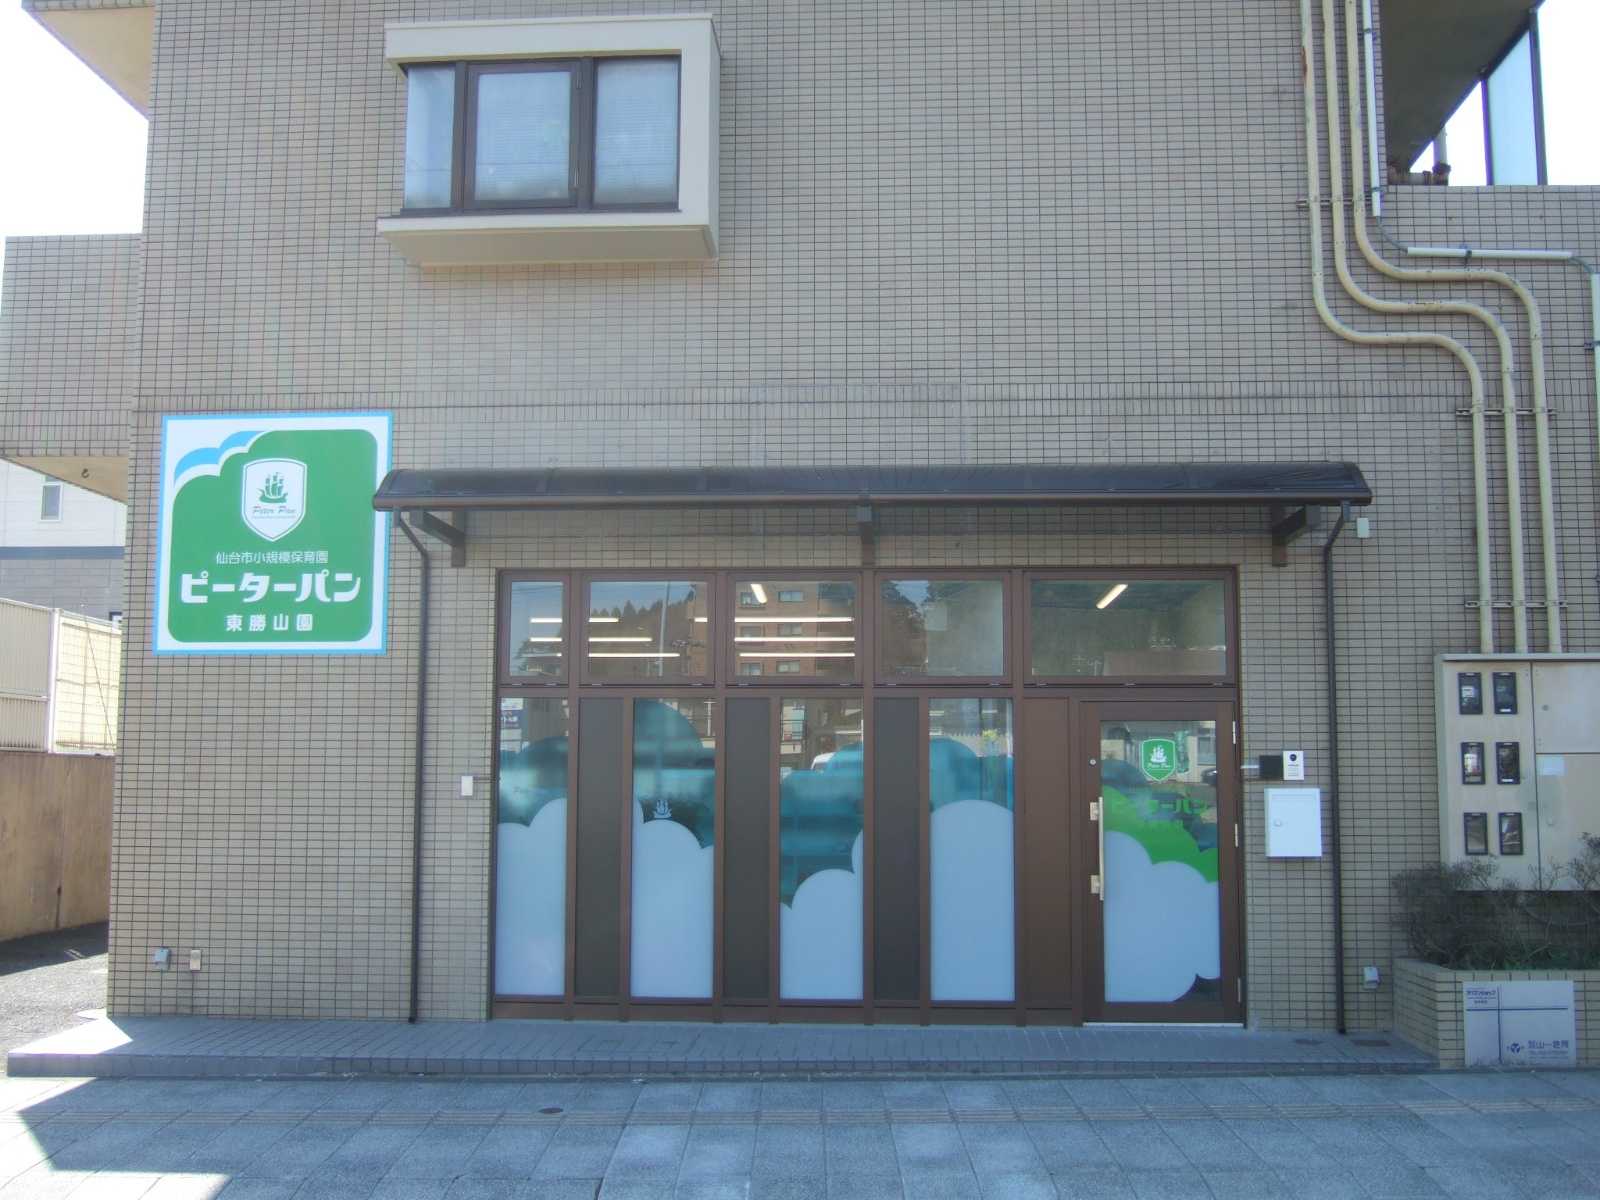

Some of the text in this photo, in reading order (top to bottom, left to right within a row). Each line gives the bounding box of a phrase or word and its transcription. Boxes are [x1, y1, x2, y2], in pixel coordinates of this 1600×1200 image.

[216, 551, 328, 564] 仙台市小規模保育園
[181, 569, 361, 604] ピーターパン
[226, 614, 313, 632] 東勝山園
